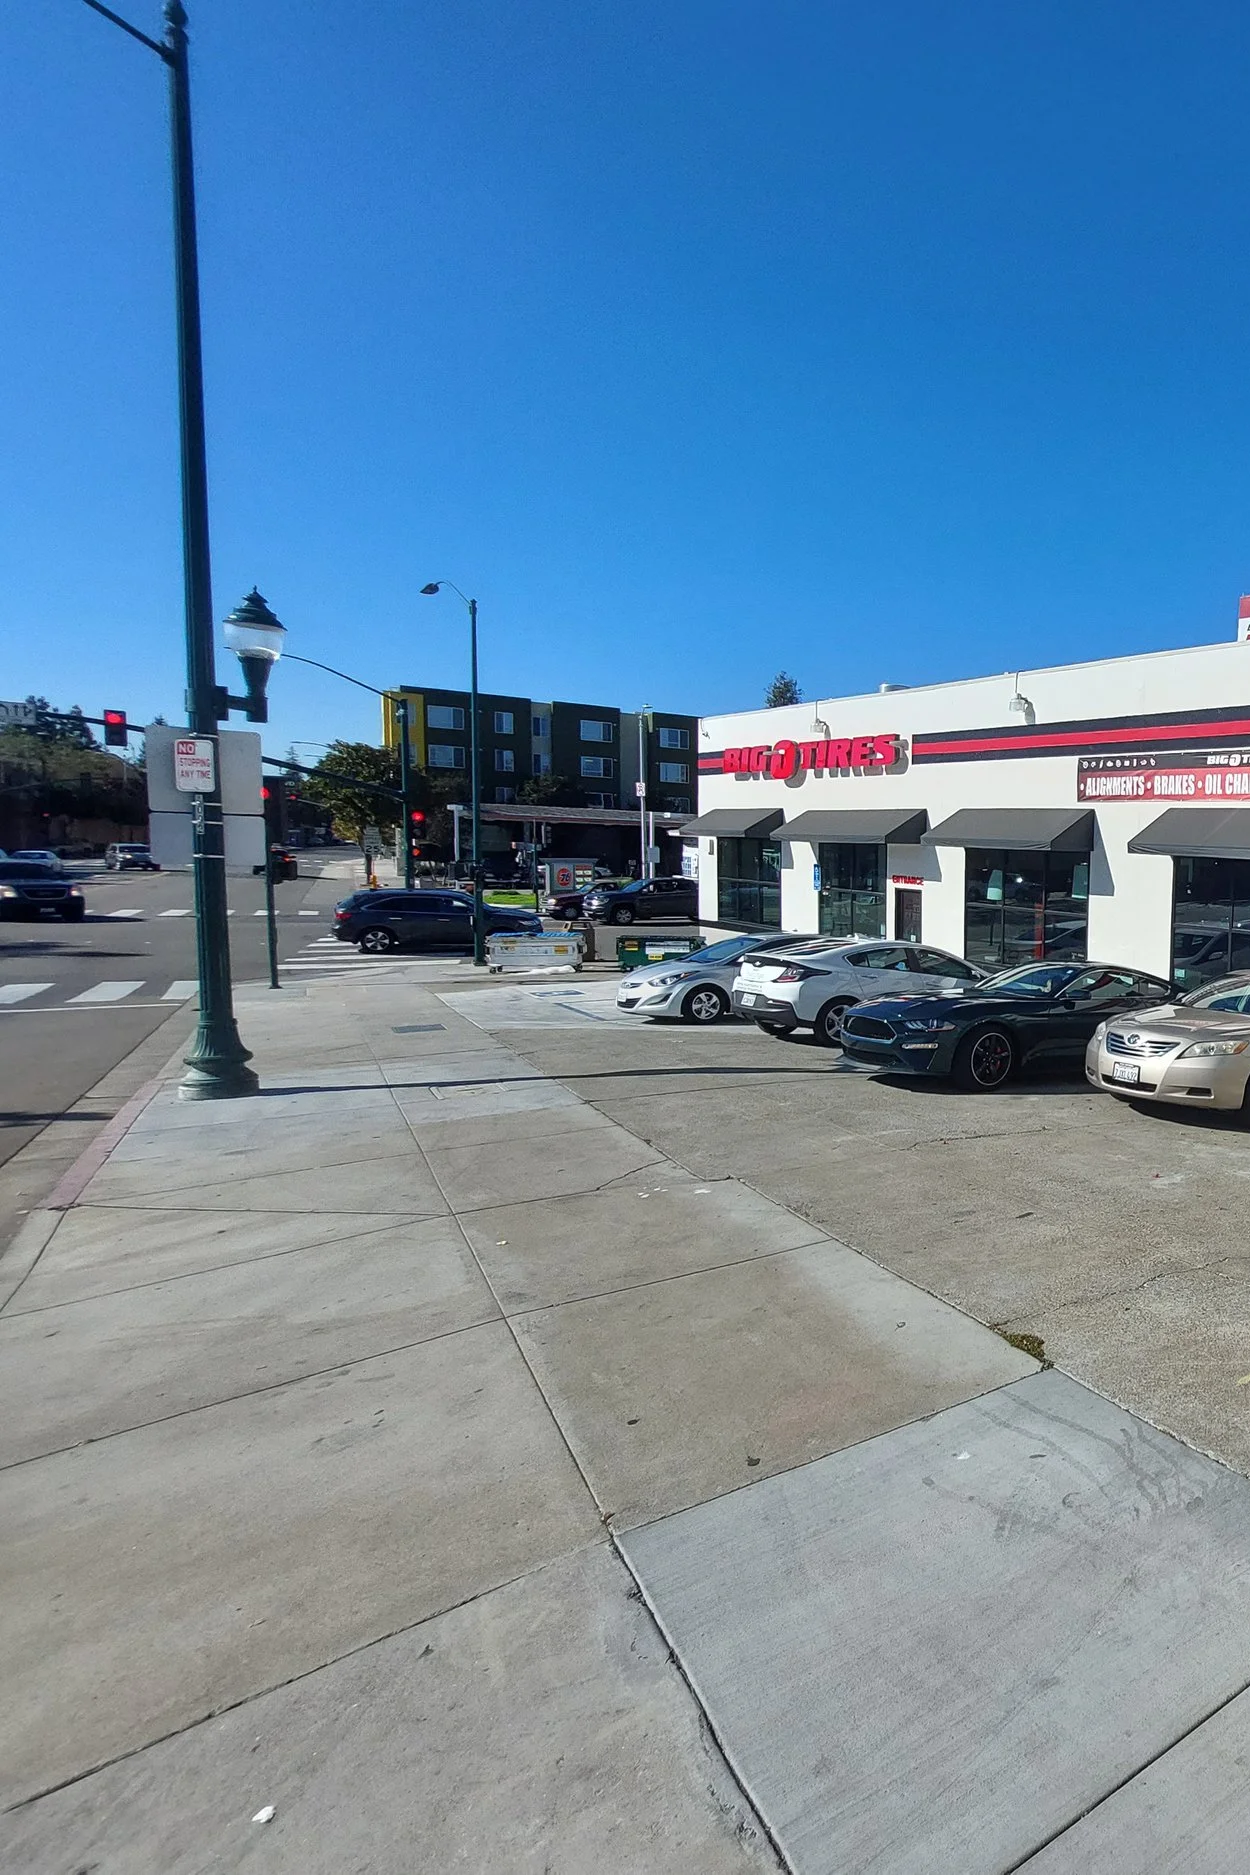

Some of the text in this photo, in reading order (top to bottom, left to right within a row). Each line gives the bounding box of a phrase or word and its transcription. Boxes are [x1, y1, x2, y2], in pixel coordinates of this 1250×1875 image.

[178, 743, 195, 754] NO
[723, 733, 900, 779] BIG O TIRES
[1206, 754, 1229, 765] BIG
[1229, 753, 1241, 767] O
[180, 757, 211, 767] STOPPING
[180, 769, 195, 779] ANY
[1085, 775, 1145, 796] ALIGNMENTS
[1154, 774, 1195, 796] BRAKES
[1205, 773, 1222, 795] OIL
[365, 845, 380, 853] 25
[559, 872, 570, 882] 76
[892, 874, 924, 885] ENTRANCE
